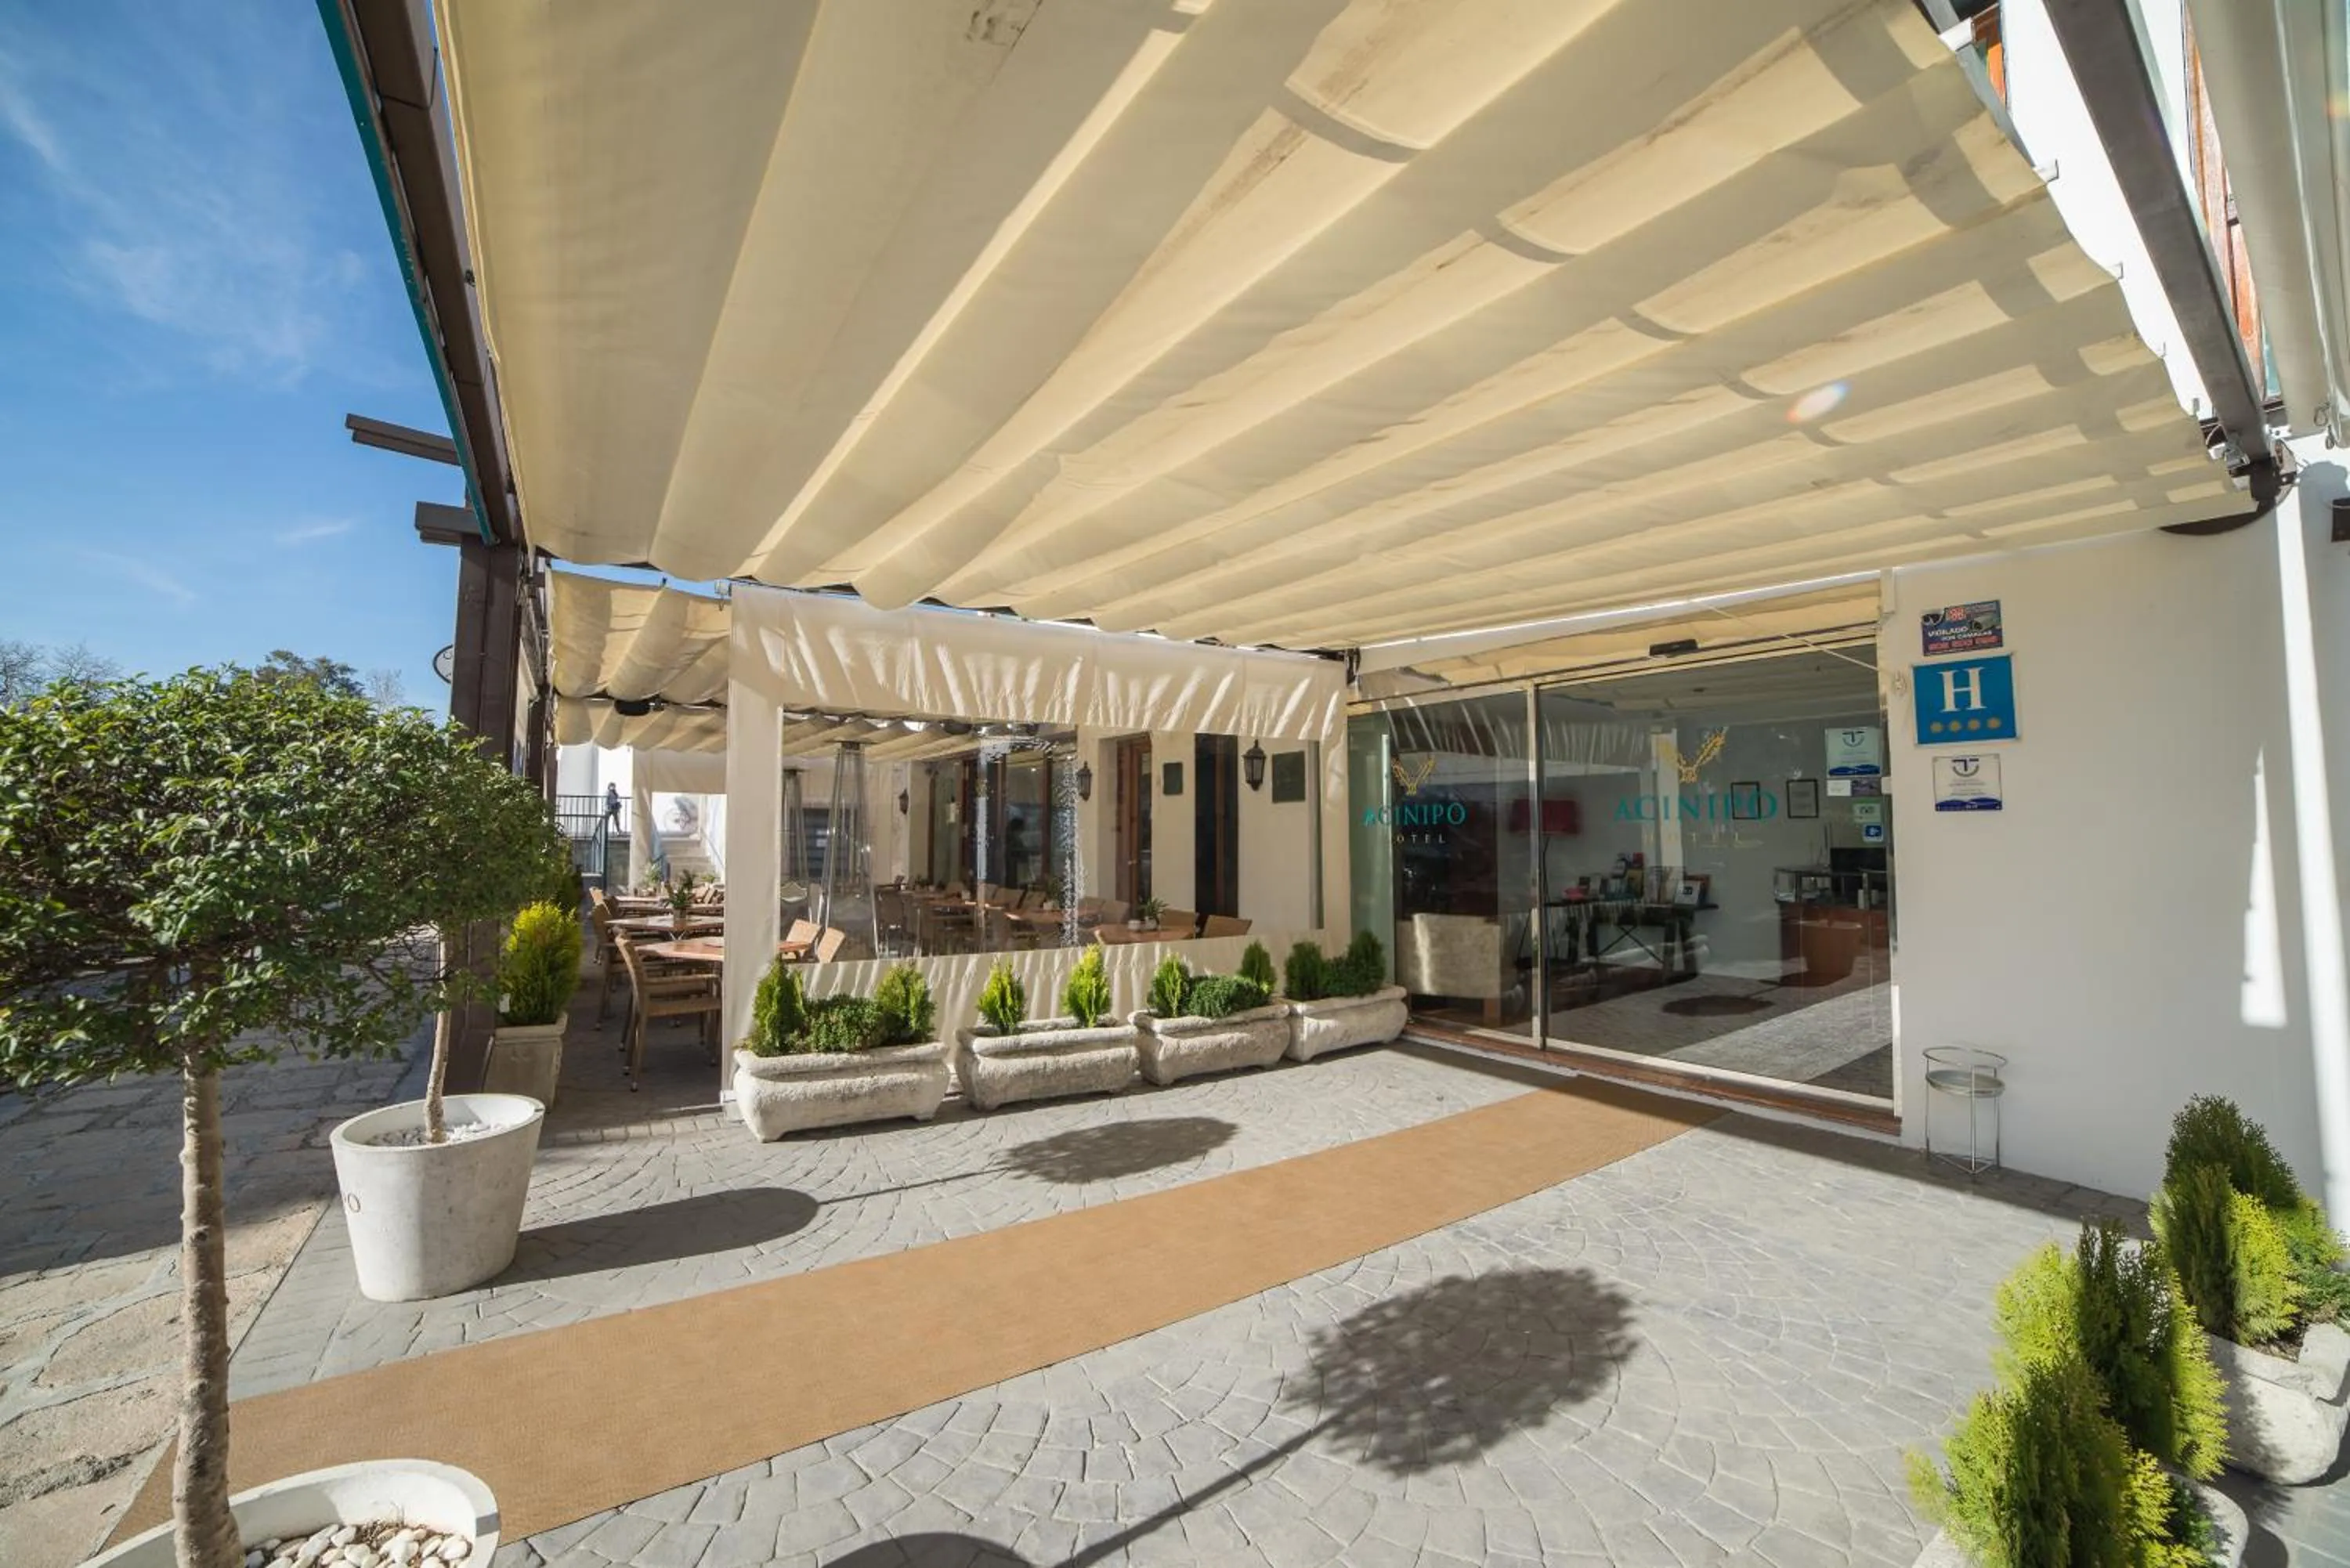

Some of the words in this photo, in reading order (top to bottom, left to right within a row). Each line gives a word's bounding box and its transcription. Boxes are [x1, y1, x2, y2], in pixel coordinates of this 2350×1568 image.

[1939, 667, 1987, 712] H
[1361, 801, 1466, 827] ACINIPO
[1614, 791, 1778, 822] ACINIPO
[1397, 833, 1446, 844] OTEL
